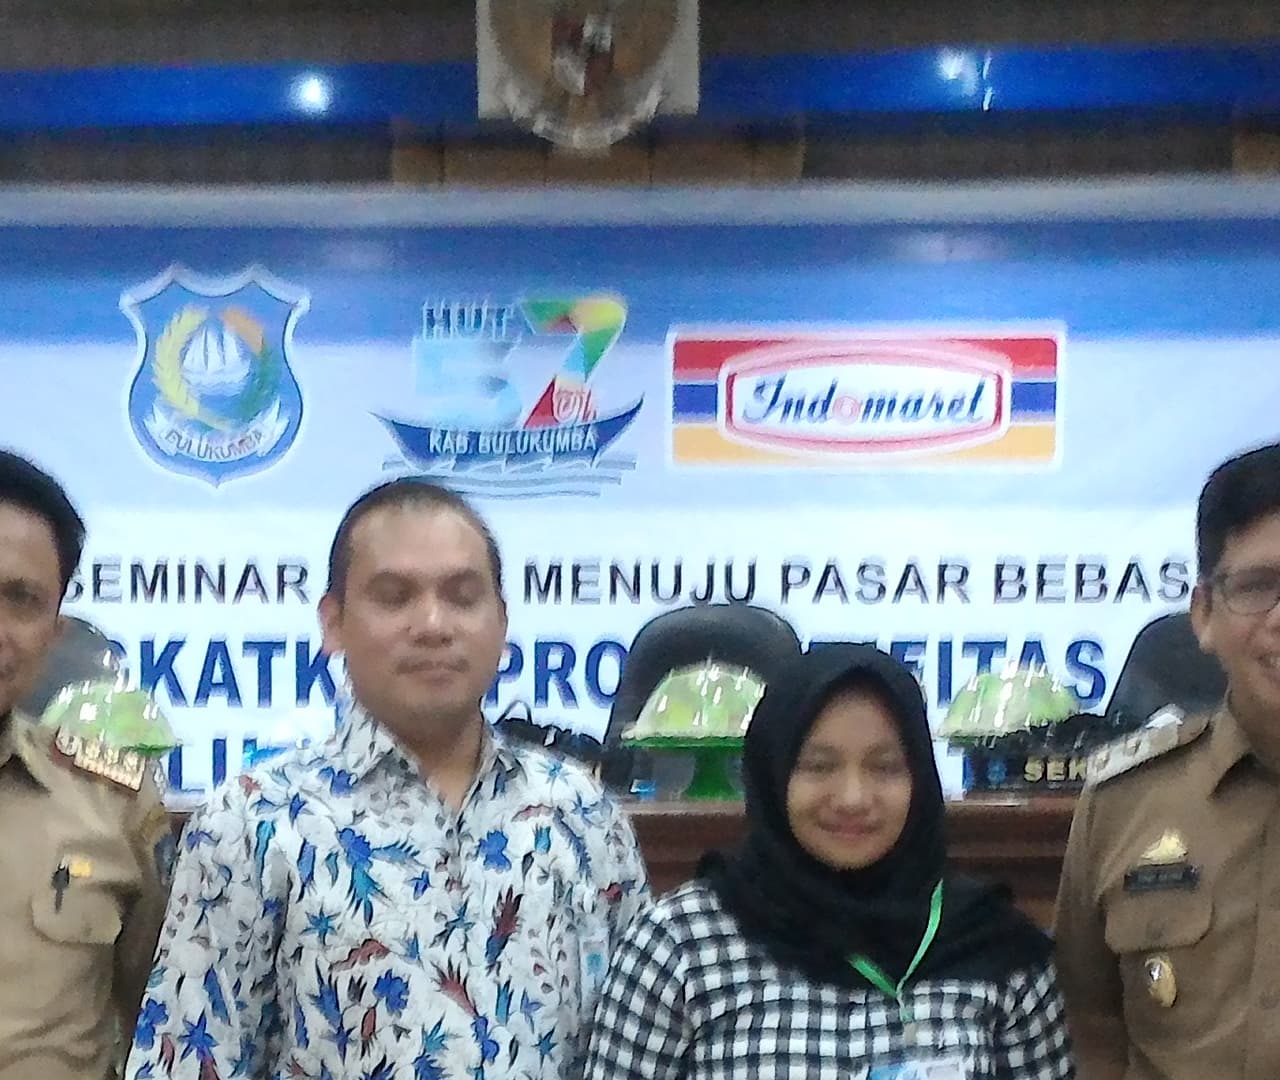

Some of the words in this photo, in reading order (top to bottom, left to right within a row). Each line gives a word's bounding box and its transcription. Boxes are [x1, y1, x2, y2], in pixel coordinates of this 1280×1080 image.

[422, 299, 515, 340] HUT
[741, 372, 986, 425] Indomaret
[478, 429, 596, 453] BULUKUMBA
[522, 556, 757, 606] MENUJU
[780, 556, 971, 604] PASAR
[993, 553, 1193, 604] BEBAS
